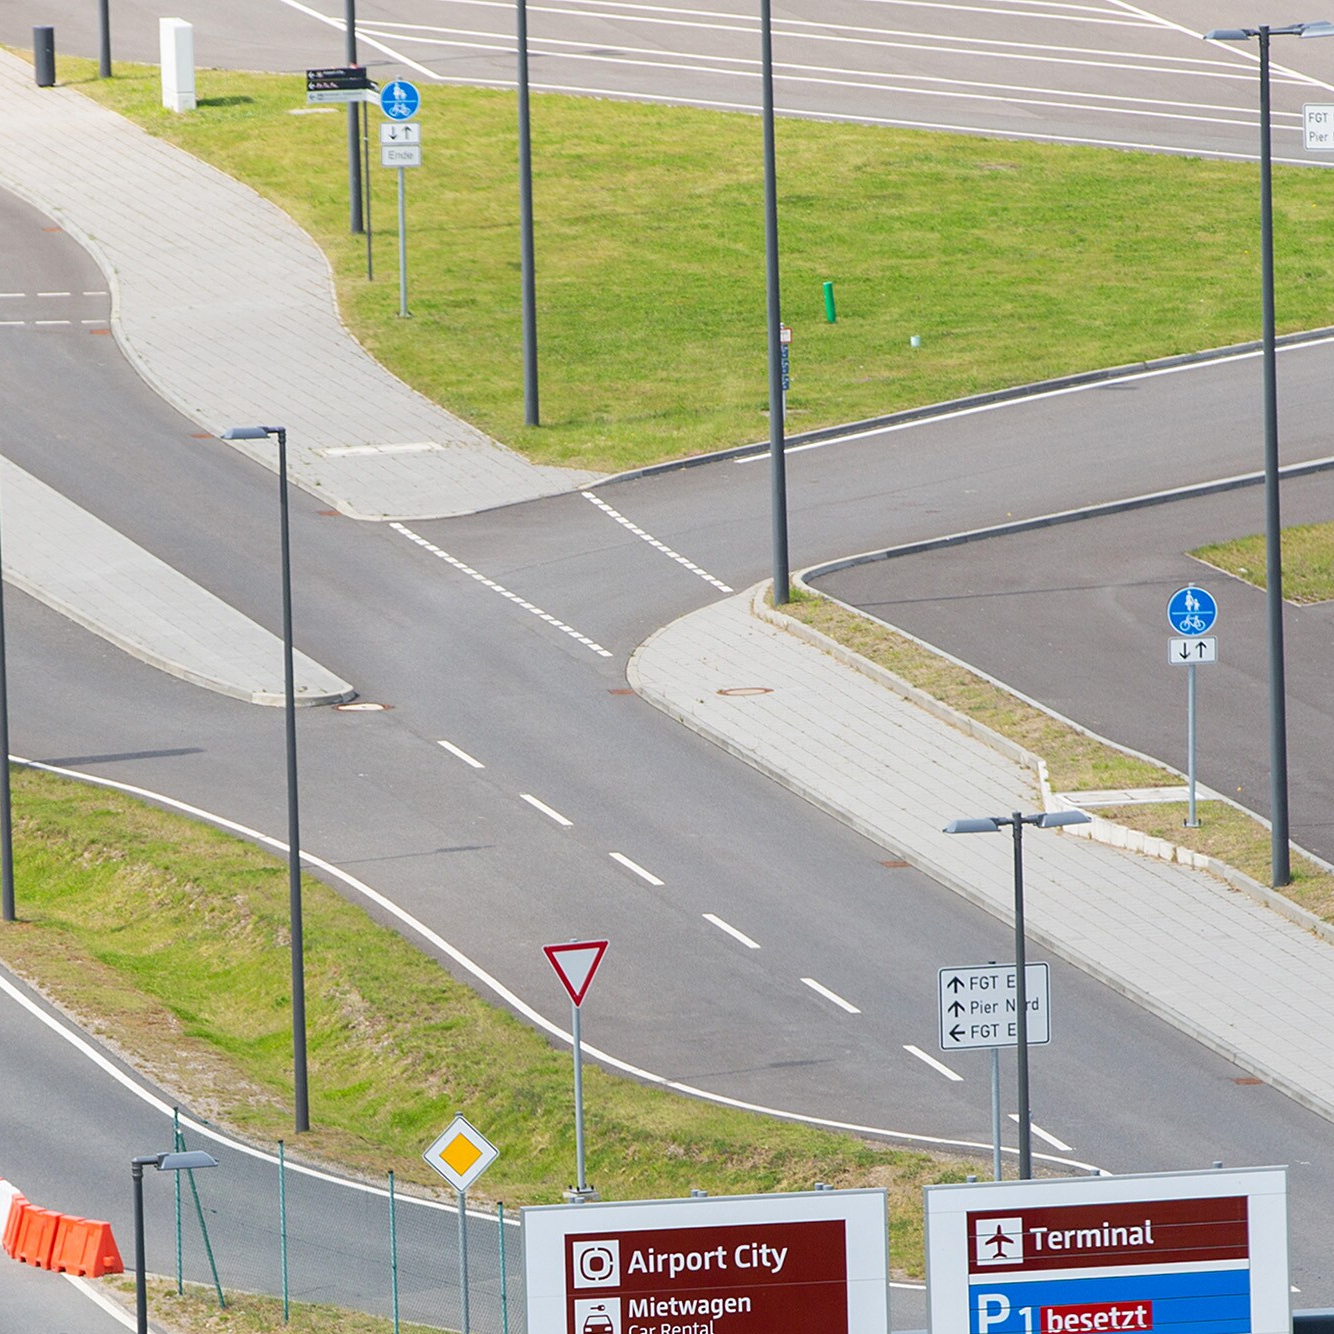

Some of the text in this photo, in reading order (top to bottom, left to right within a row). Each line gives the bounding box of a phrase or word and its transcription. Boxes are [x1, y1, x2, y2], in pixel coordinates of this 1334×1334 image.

[1308, 112, 1328, 123] FGT
[1309, 132, 1328, 142] Pier
[388, 150, 413, 160] Ende
[970, 975, 998, 990] FGT
[970, 997, 1039, 1014] Pier Nrd
[971, 1024, 999, 1038] FGT
[1029, 1220, 1154, 1251] Terminal
[627, 1242, 788, 1279] Airport City
[628, 1296, 751, 1320] Mietwagen
[1046, 1304, 1147, 1334] besetzt
